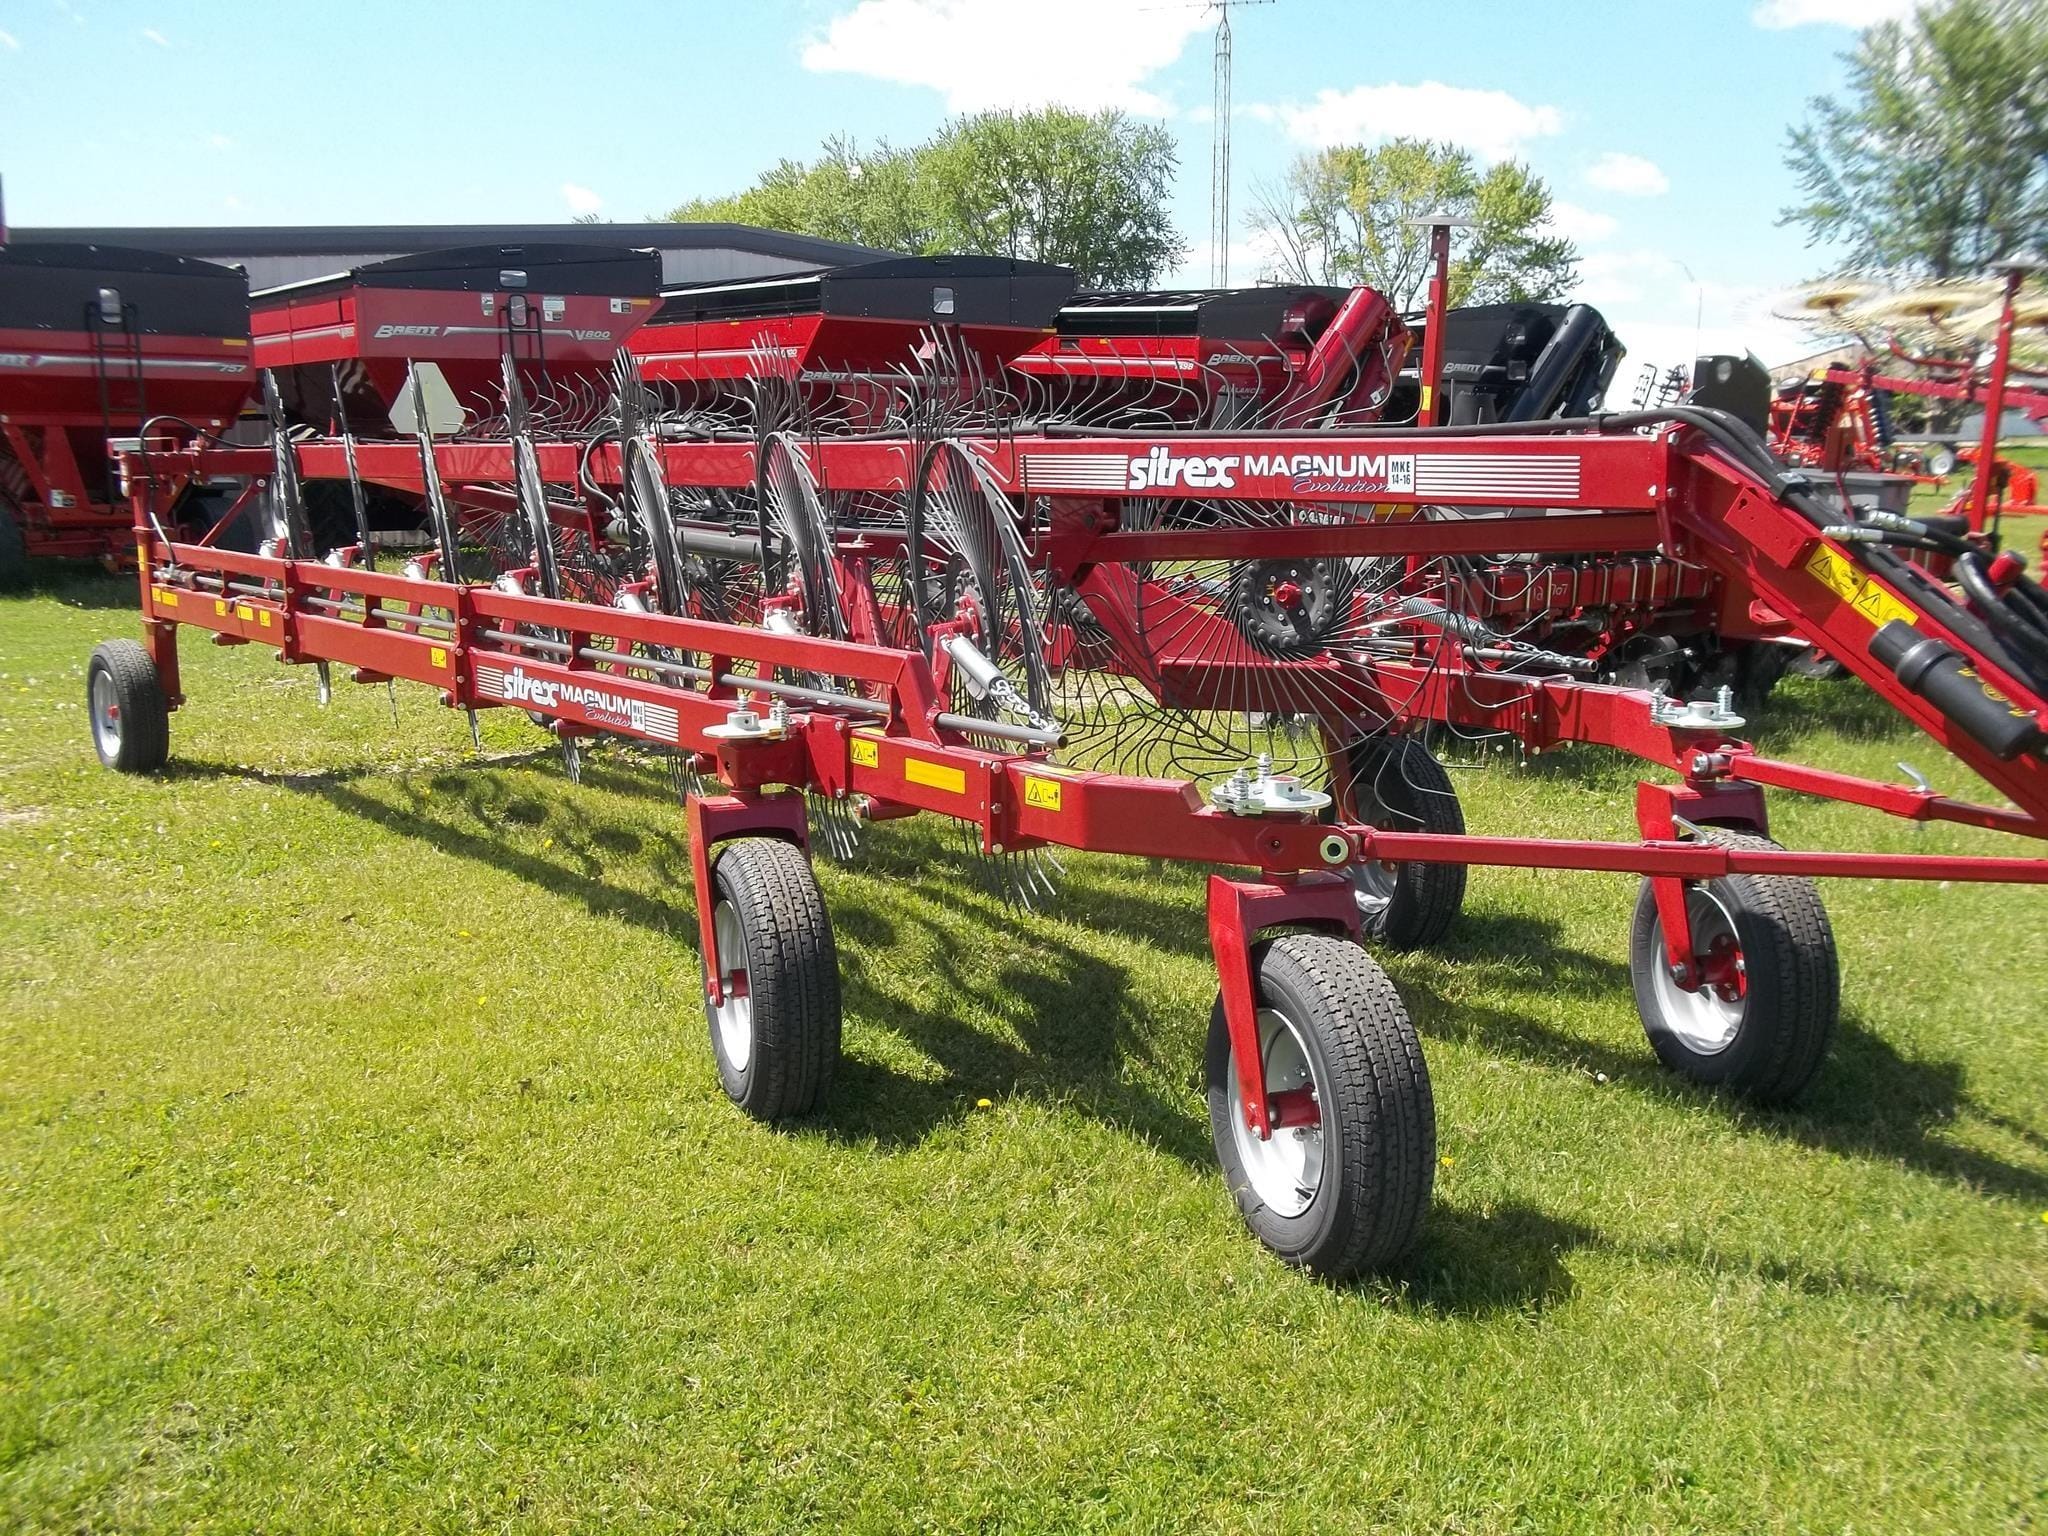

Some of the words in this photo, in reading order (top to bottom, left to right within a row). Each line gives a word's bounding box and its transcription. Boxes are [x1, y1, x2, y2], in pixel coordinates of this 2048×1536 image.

[574, 330, 612, 341] V800
[218, 364, 247, 373] 757
[1129, 446, 1238, 490] sitrex
[1243, 455, 1386, 478] MAGNUM
[1391, 461, 1411, 473] MKE
[1292, 474, 1390, 494] Evolution
[1391, 474, 1411, 485] 14-16
[503, 667, 560, 708] sitrex
[560, 683, 632, 716] MAGNUM
